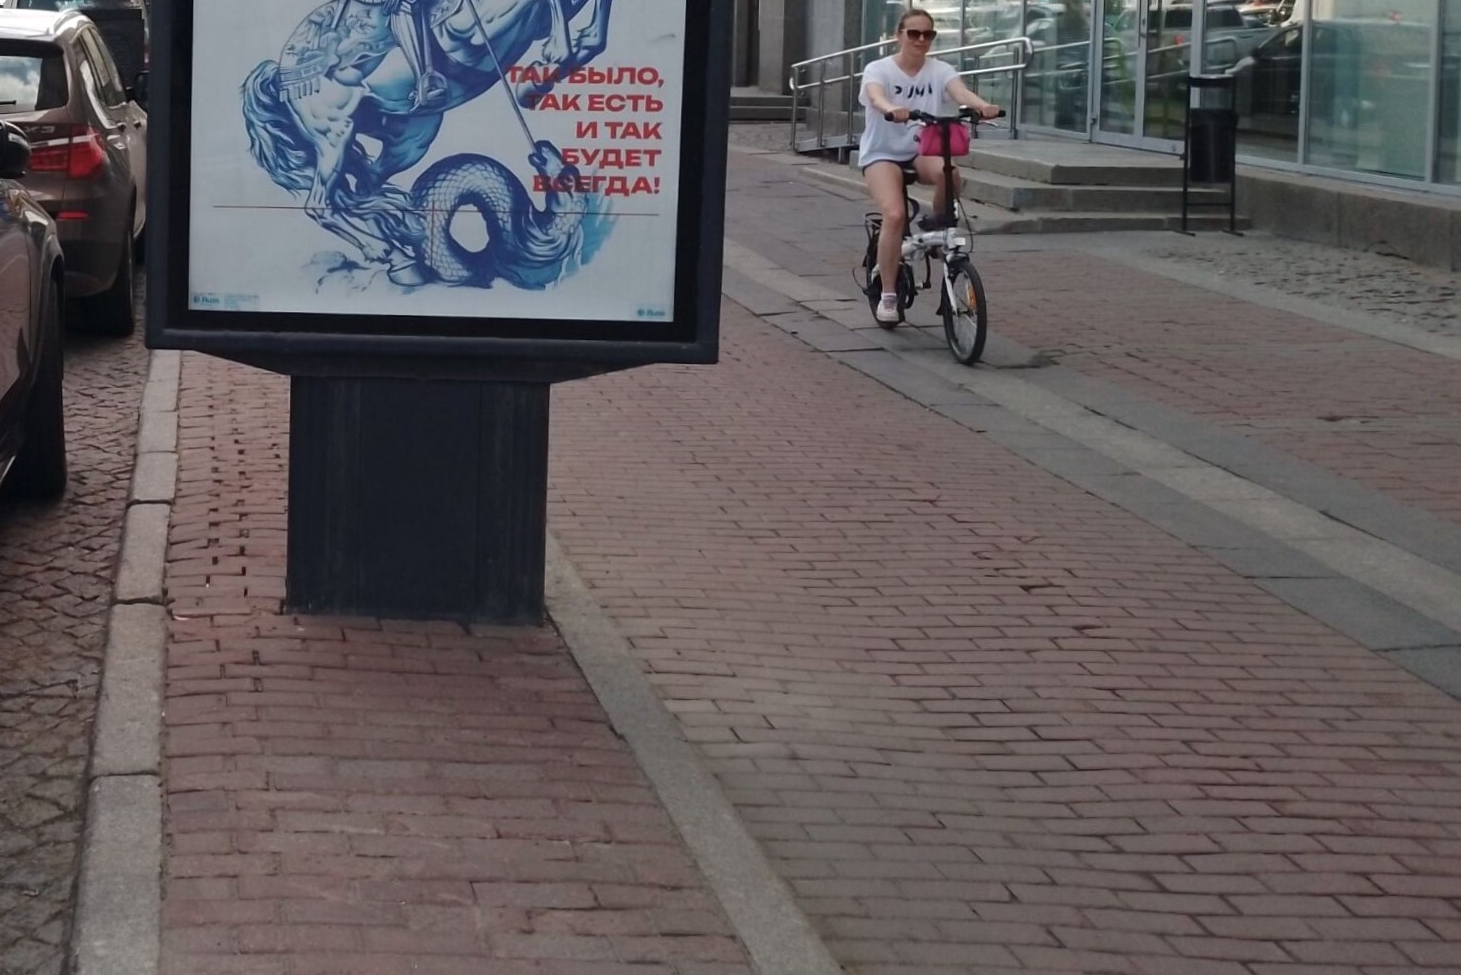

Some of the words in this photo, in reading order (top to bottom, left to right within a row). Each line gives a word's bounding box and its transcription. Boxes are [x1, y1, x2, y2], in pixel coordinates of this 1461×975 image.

[508, 66, 562, 85] ТАК
[568, 67, 665, 88] БЫЛО,
[527, 94, 581, 112] ТАК
[587, 94, 664, 113] ЕСТЬ
[576, 121, 598, 139] И
[604, 122, 663, 140] ТАК
[561, 148, 662, 169] БУДЕТ
[533, 175, 661, 197] ВСЕГДА!
